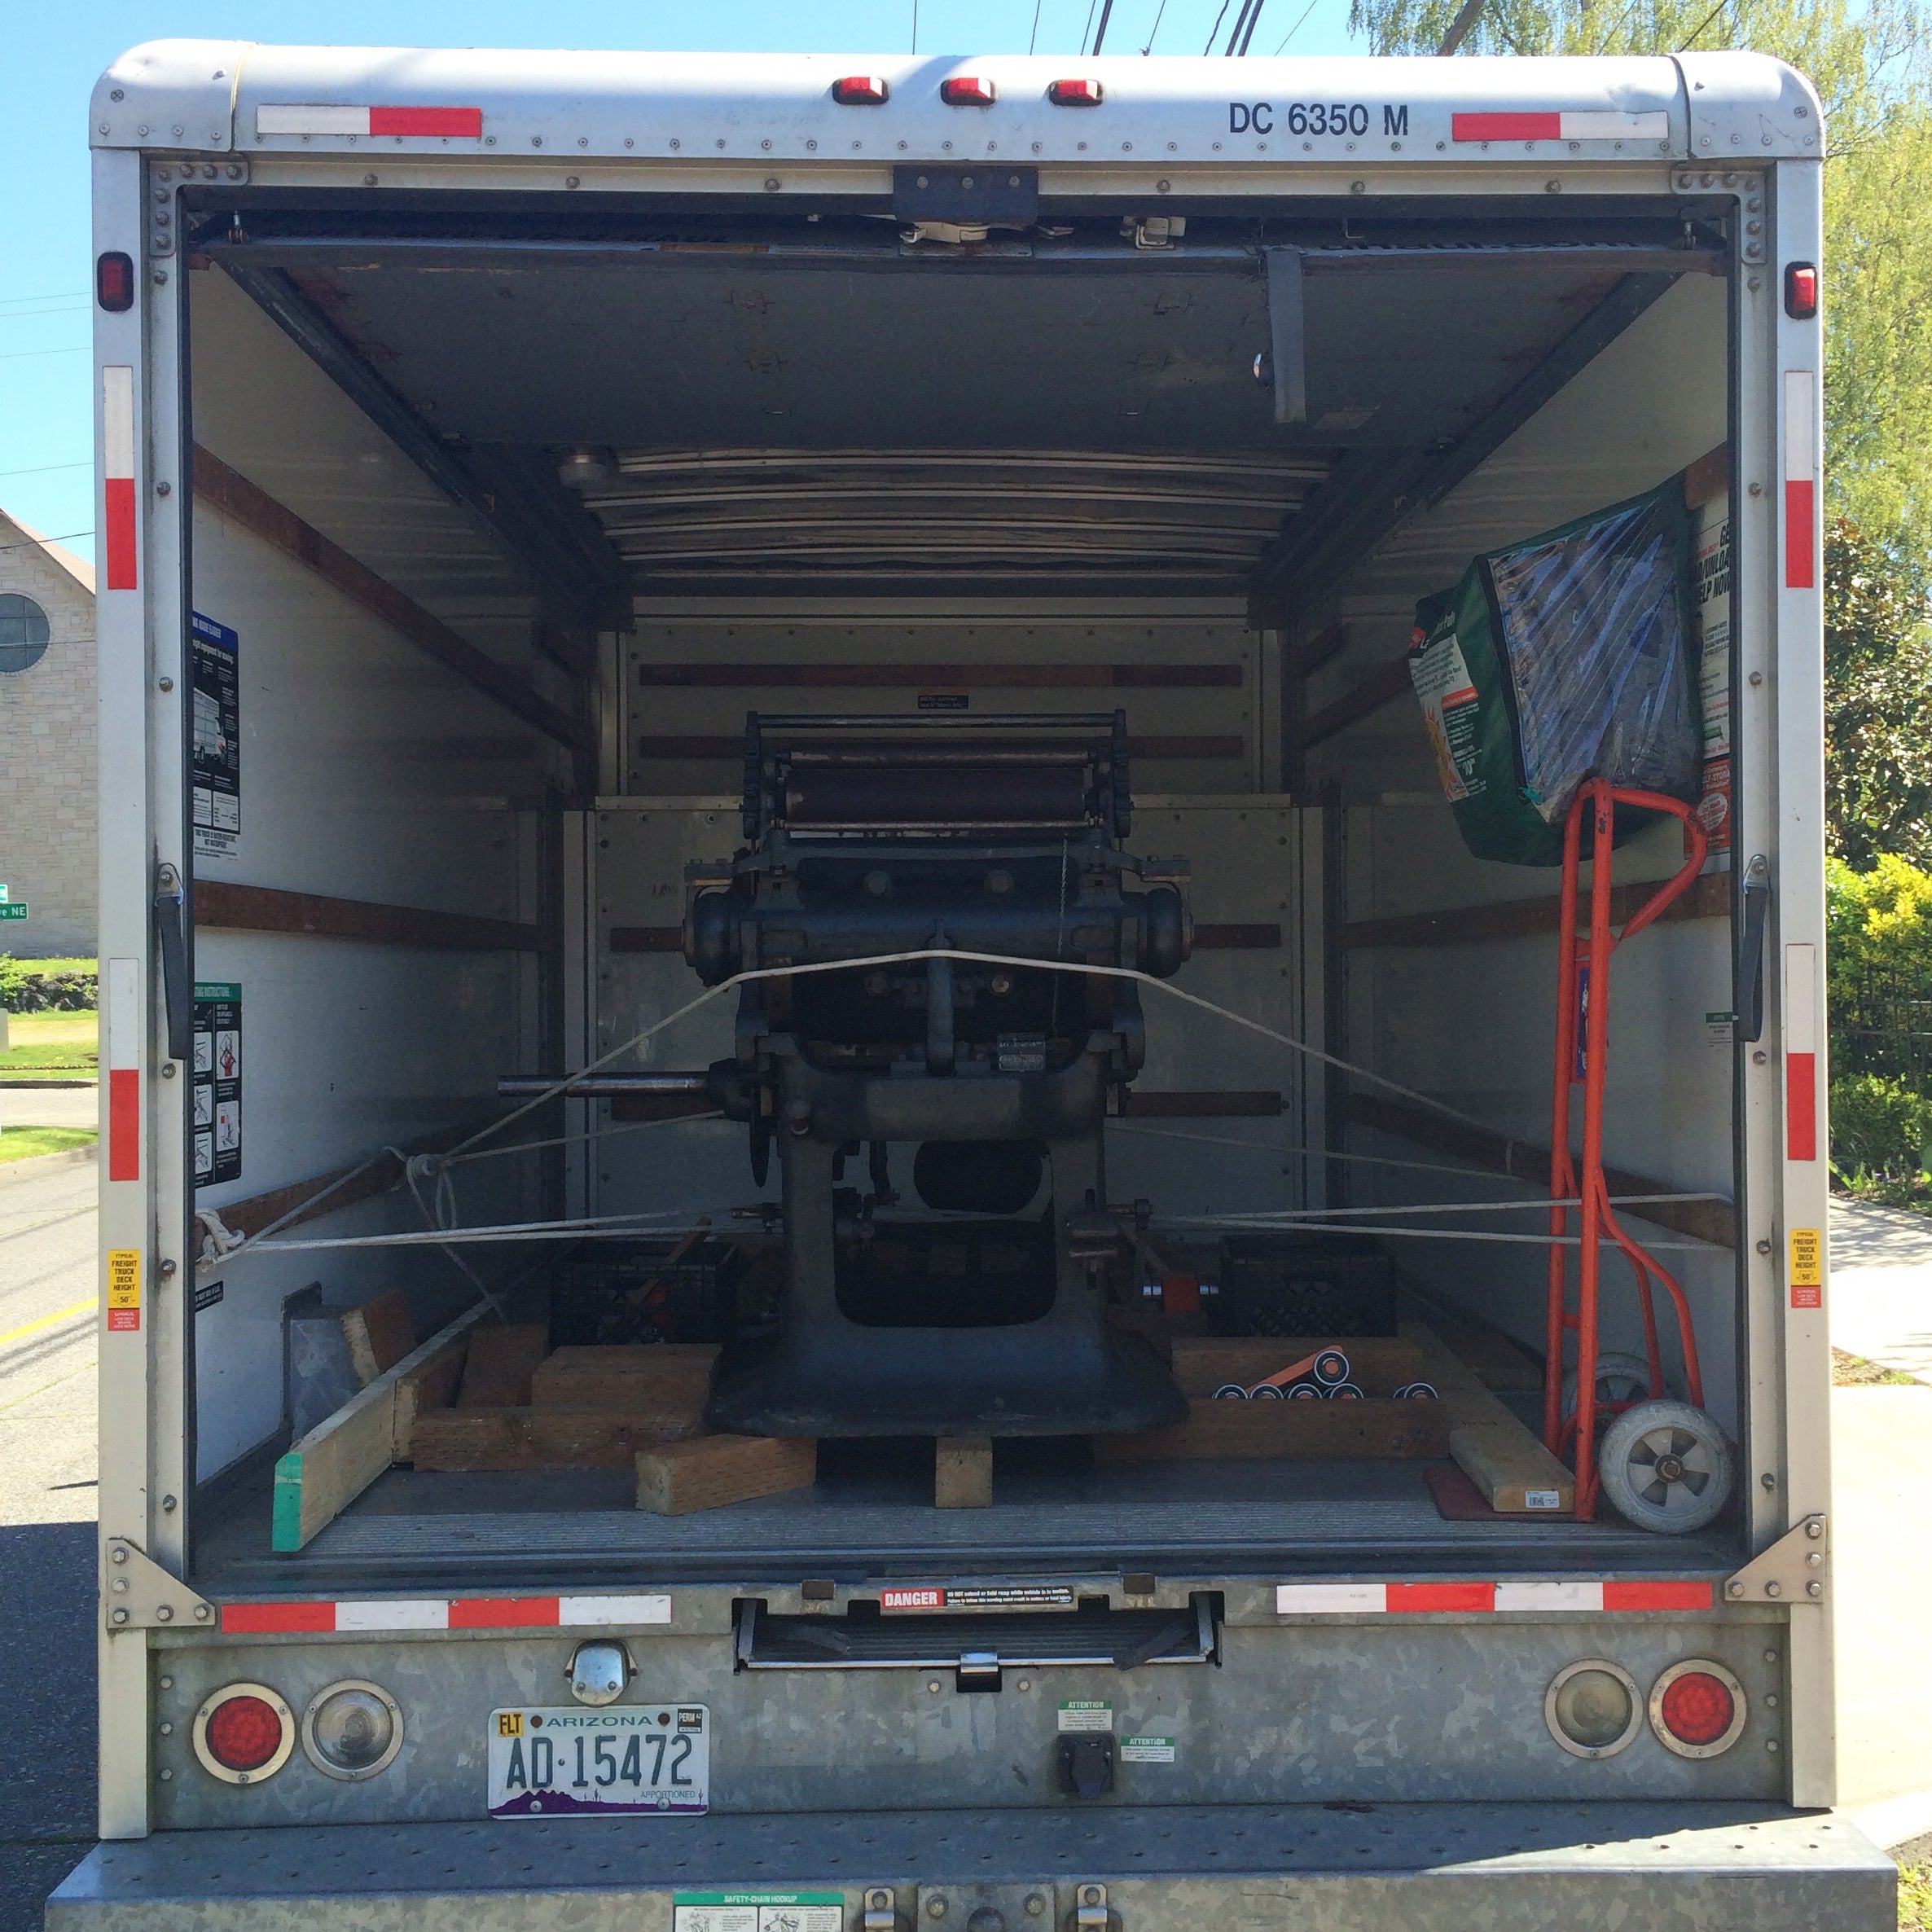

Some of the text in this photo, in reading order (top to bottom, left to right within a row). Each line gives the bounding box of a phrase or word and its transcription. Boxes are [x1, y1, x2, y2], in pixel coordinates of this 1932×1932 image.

[1229, 102, 1408, 136] DC 6350 M
[11, 907, 26, 916] NE
[885, 1592, 937, 1606] DANGER
[1068, 1701, 1104, 1709] ATTENTION
[499, 1714, 522, 1735] FLT
[547, 1716, 653, 1728] ARIZONA
[678, 1712, 696, 1723] PERM
[1129, 1737, 1166, 1745] ATTENTION
[640, 1790, 696, 1798] APPORTIONED
[723, 1895, 771, 1903] SAFETY-CHAIN
